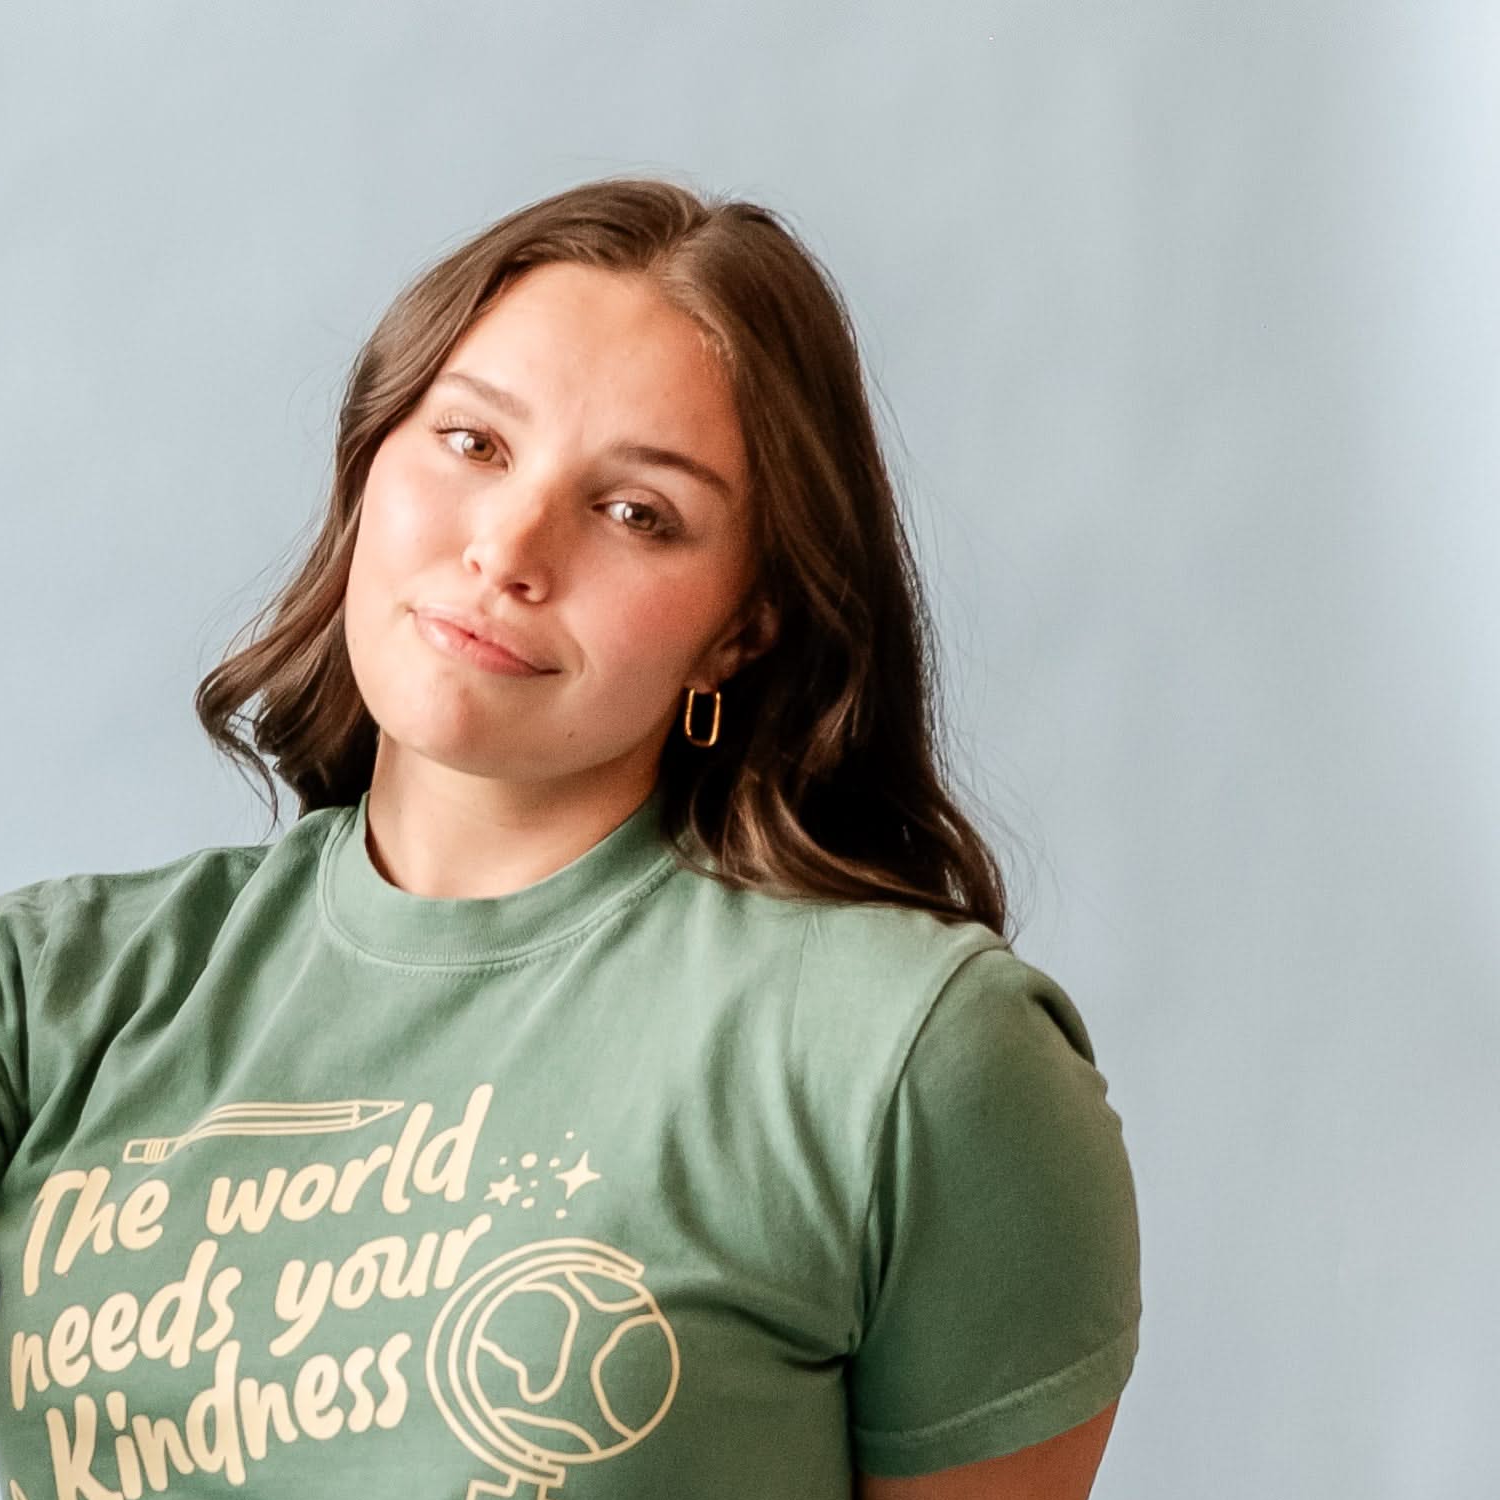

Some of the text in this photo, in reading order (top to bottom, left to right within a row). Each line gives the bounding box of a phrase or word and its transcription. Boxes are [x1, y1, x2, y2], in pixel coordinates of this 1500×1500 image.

[23, 1083, 494, 1297] The world
[10, 1214, 493, 1411] needs your
